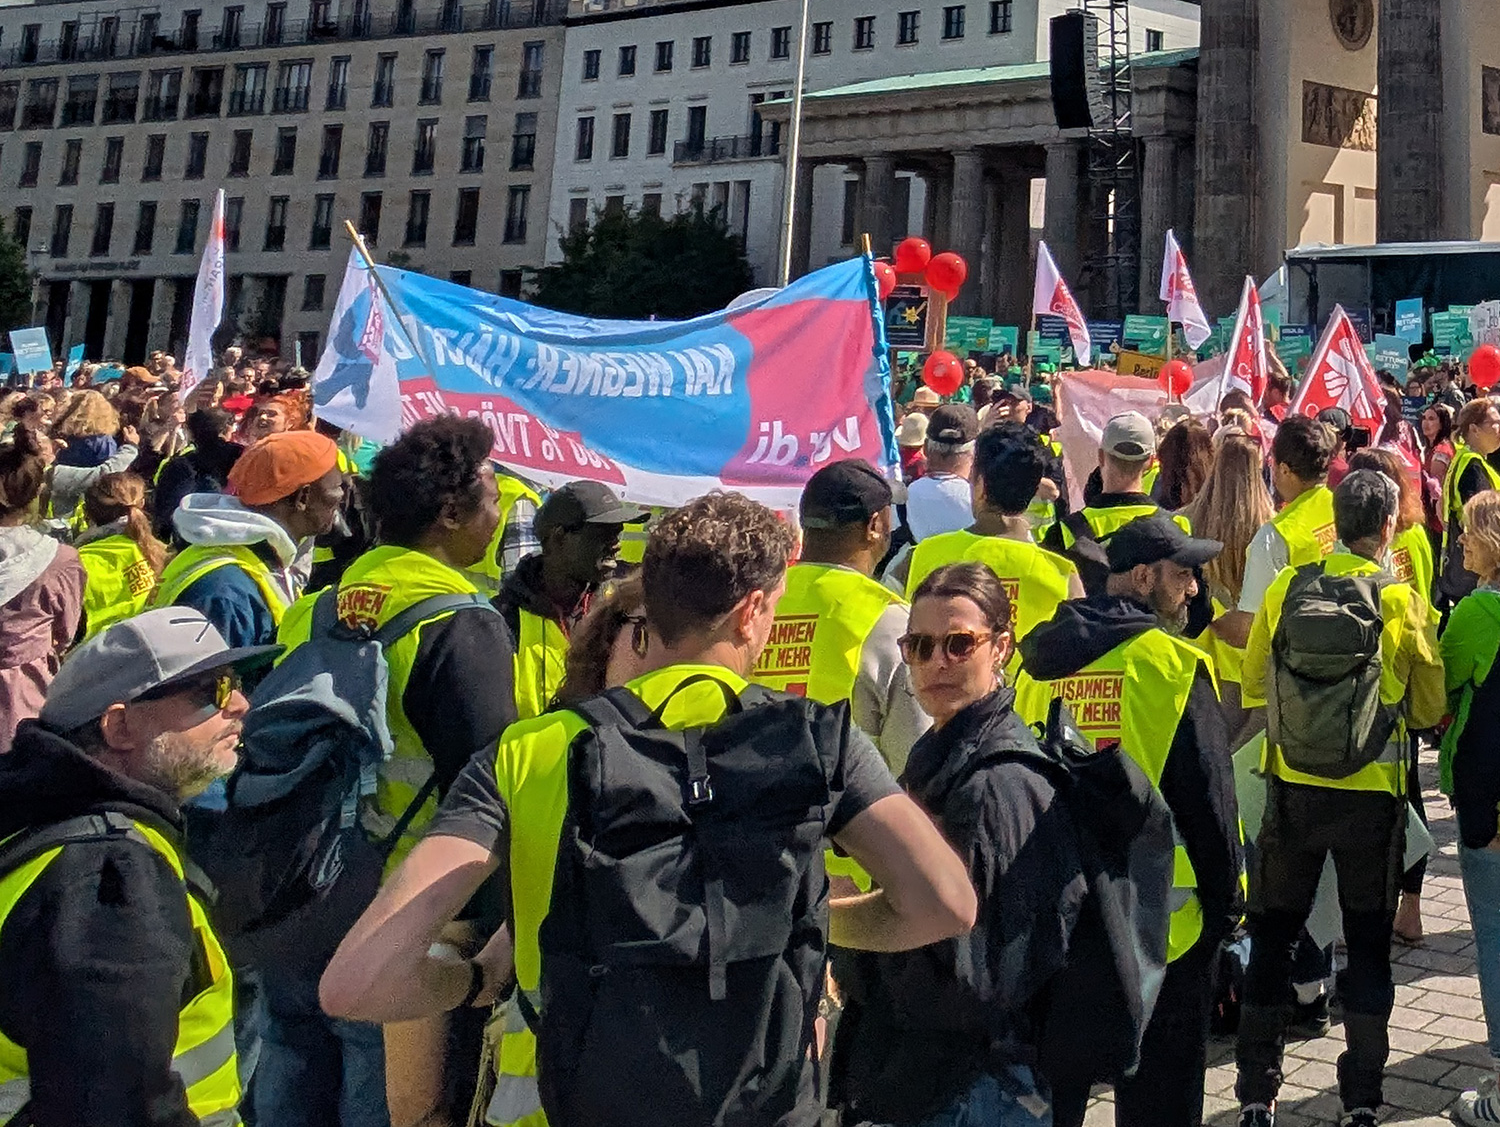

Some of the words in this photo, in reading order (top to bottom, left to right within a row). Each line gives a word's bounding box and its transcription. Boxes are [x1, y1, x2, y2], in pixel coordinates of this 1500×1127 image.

[776, 646, 812, 669] MEHR
[1050, 677, 1124, 701] ZUSAMMEN
[1082, 702, 1122, 723] MEHR
